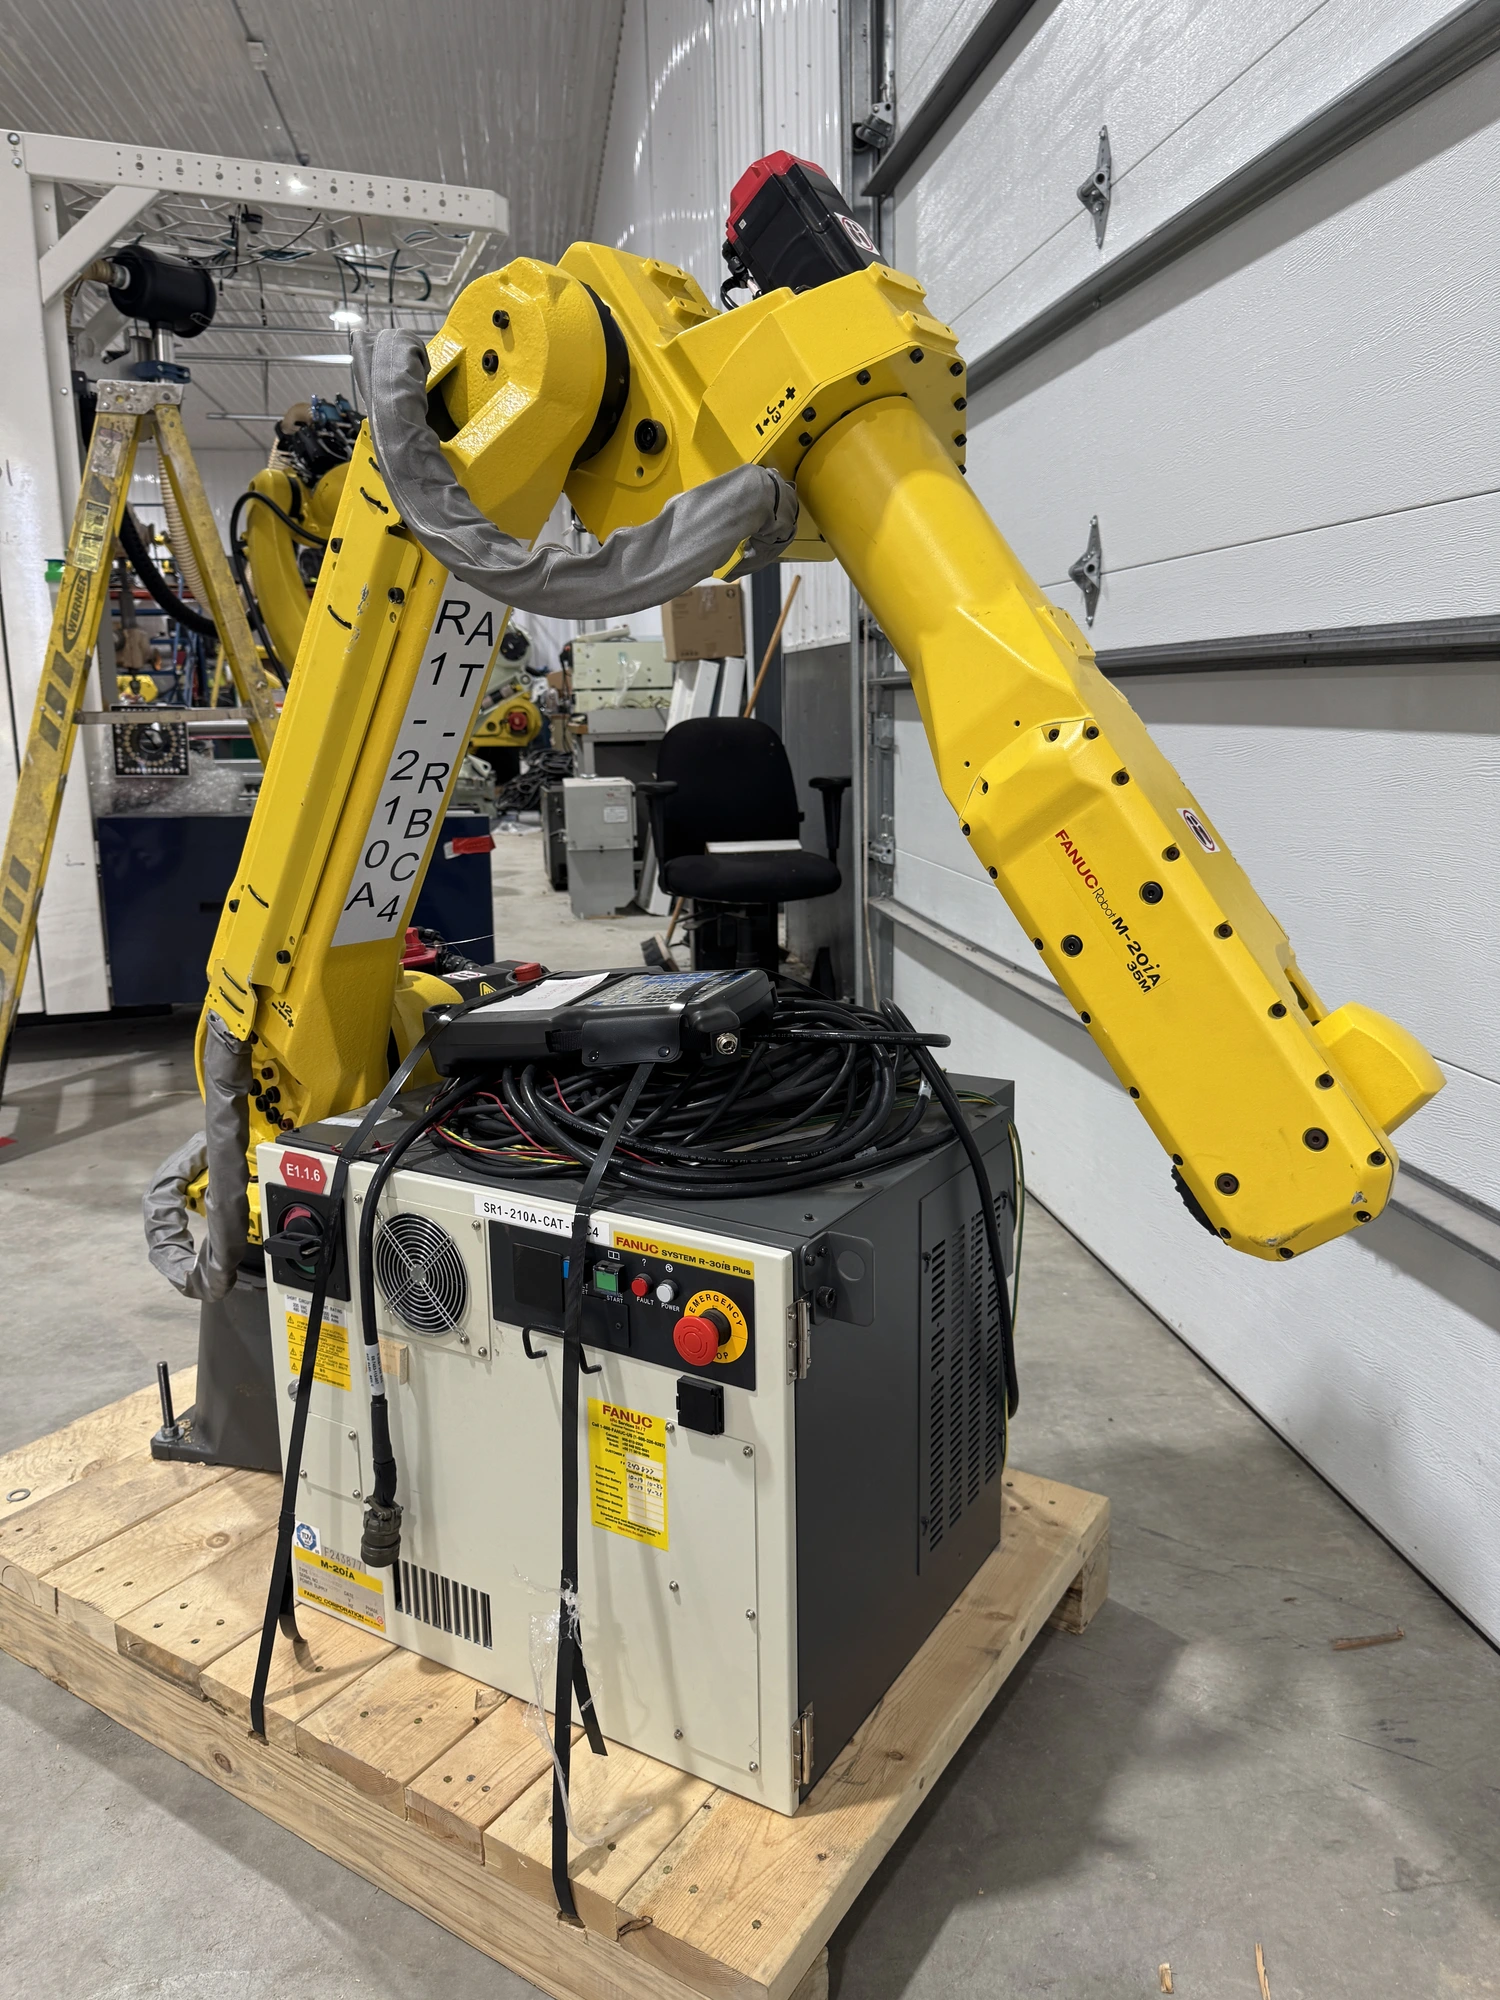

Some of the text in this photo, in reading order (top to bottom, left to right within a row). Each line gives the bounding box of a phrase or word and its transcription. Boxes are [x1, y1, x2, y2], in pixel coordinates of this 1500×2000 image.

[67, 576, 88, 634] WERNER
[1055, 829, 1098, 889] FANUC
[1092, 887, 1117, 919] Robot
[1126, 961, 1151, 993] 35M
[286, 1163, 321, 1182] E1.1.6
[483, 1202, 599, 1238] SR1-210A-CAT-C4
[616, 1236, 751, 1275] FANUC SYSTEM R-30iB Plus
[606, 1295, 623, 1304] START
[636, 1297, 654, 1306] FAULT
[660, 1302, 680, 1313] POWER
[688, 1293, 743, 1327] EMERGENCY
[602, 1405, 653, 1428] FANUC
[320, 1559, 355, 1580] M-20iA
[324, 1546, 362, 1571] F243877
[304, 1589, 322, 1602] FANUC
[323, 1598, 364, 1620] CORPORATION
